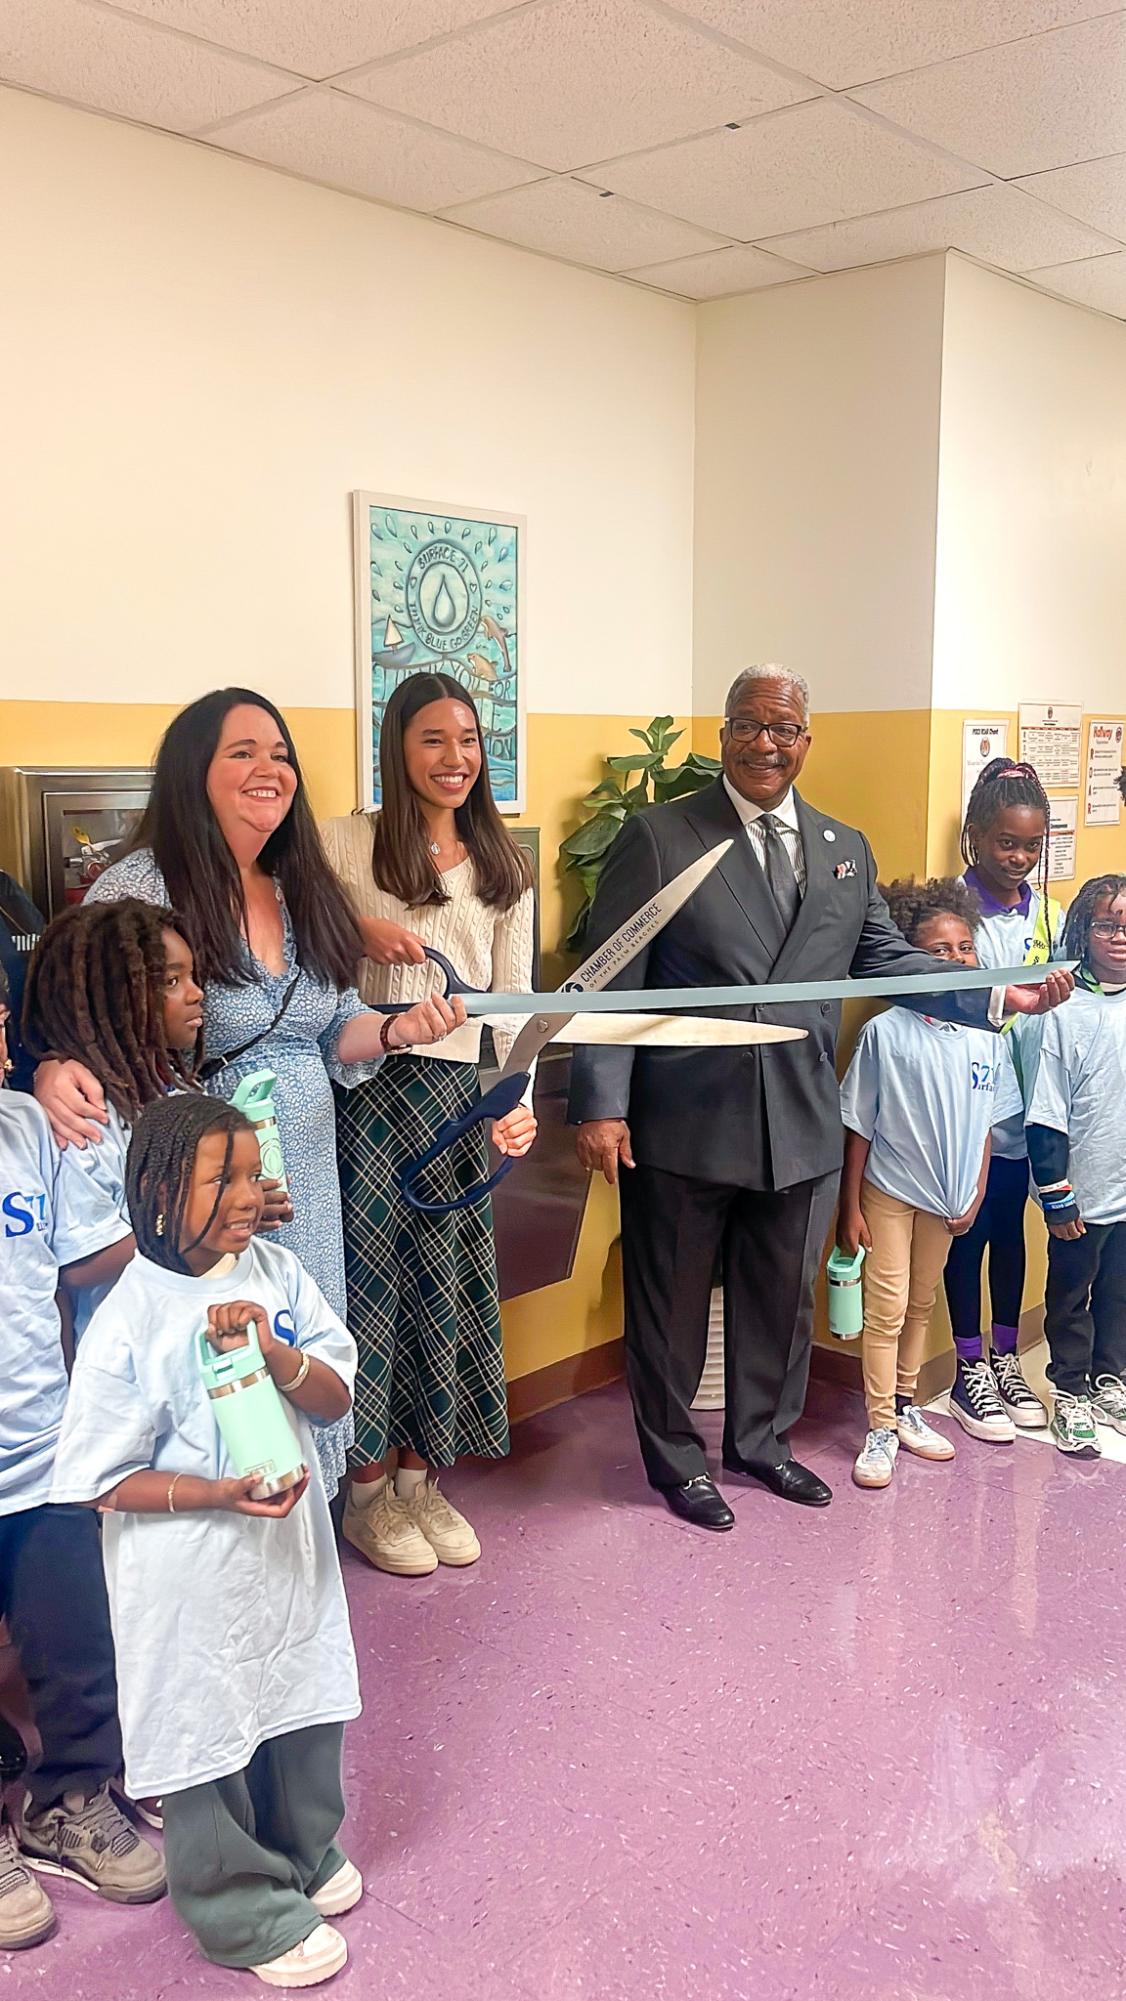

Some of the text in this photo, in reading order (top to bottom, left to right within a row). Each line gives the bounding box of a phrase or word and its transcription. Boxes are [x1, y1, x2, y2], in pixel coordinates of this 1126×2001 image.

[418, 546, 469, 573] SURFACE 71
[425, 632, 448, 651] BLUE
[450, 637, 463, 649] GO
[461, 605, 479, 641] GREEN
[580, 903, 662, 983] CHAMBER OF COMMERCE
[589, 980, 598, 988] OF
[599, 966, 612, 978] THE
